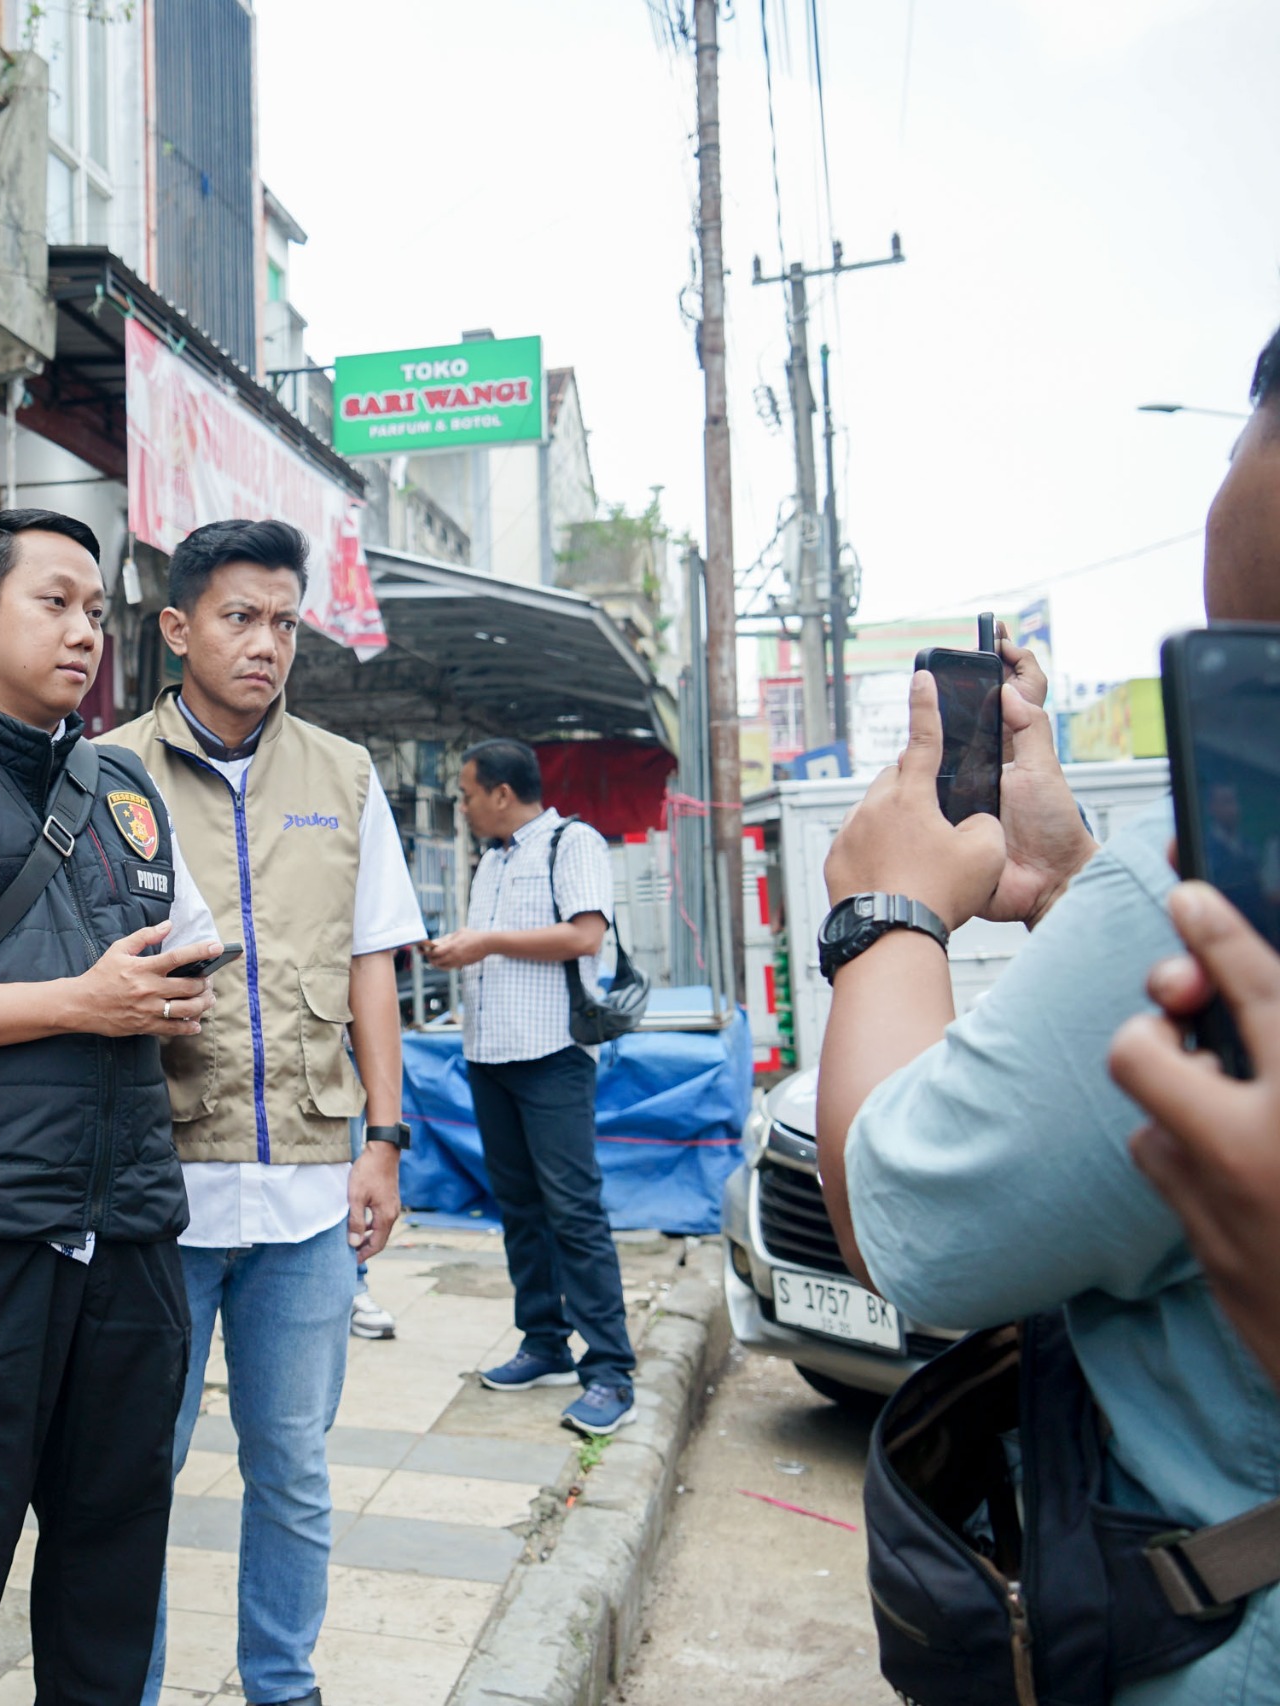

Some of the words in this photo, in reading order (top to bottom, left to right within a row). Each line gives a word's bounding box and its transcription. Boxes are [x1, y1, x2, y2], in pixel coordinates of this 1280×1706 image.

[400, 358, 469, 382] TOKO
[342, 389, 417, 420] SARI
[421, 377, 531, 411] WANGI
[369, 421, 431, 439] PARFUM
[434, 419, 447, 433] &
[450, 414, 503, 432] BOTOL
[294, 812, 339, 830] bulog
[137, 869, 168, 894] PIDTER
[778, 1277, 791, 1304] S
[803, 1282, 850, 1317] 1757
[866, 1294, 893, 1330] BK
